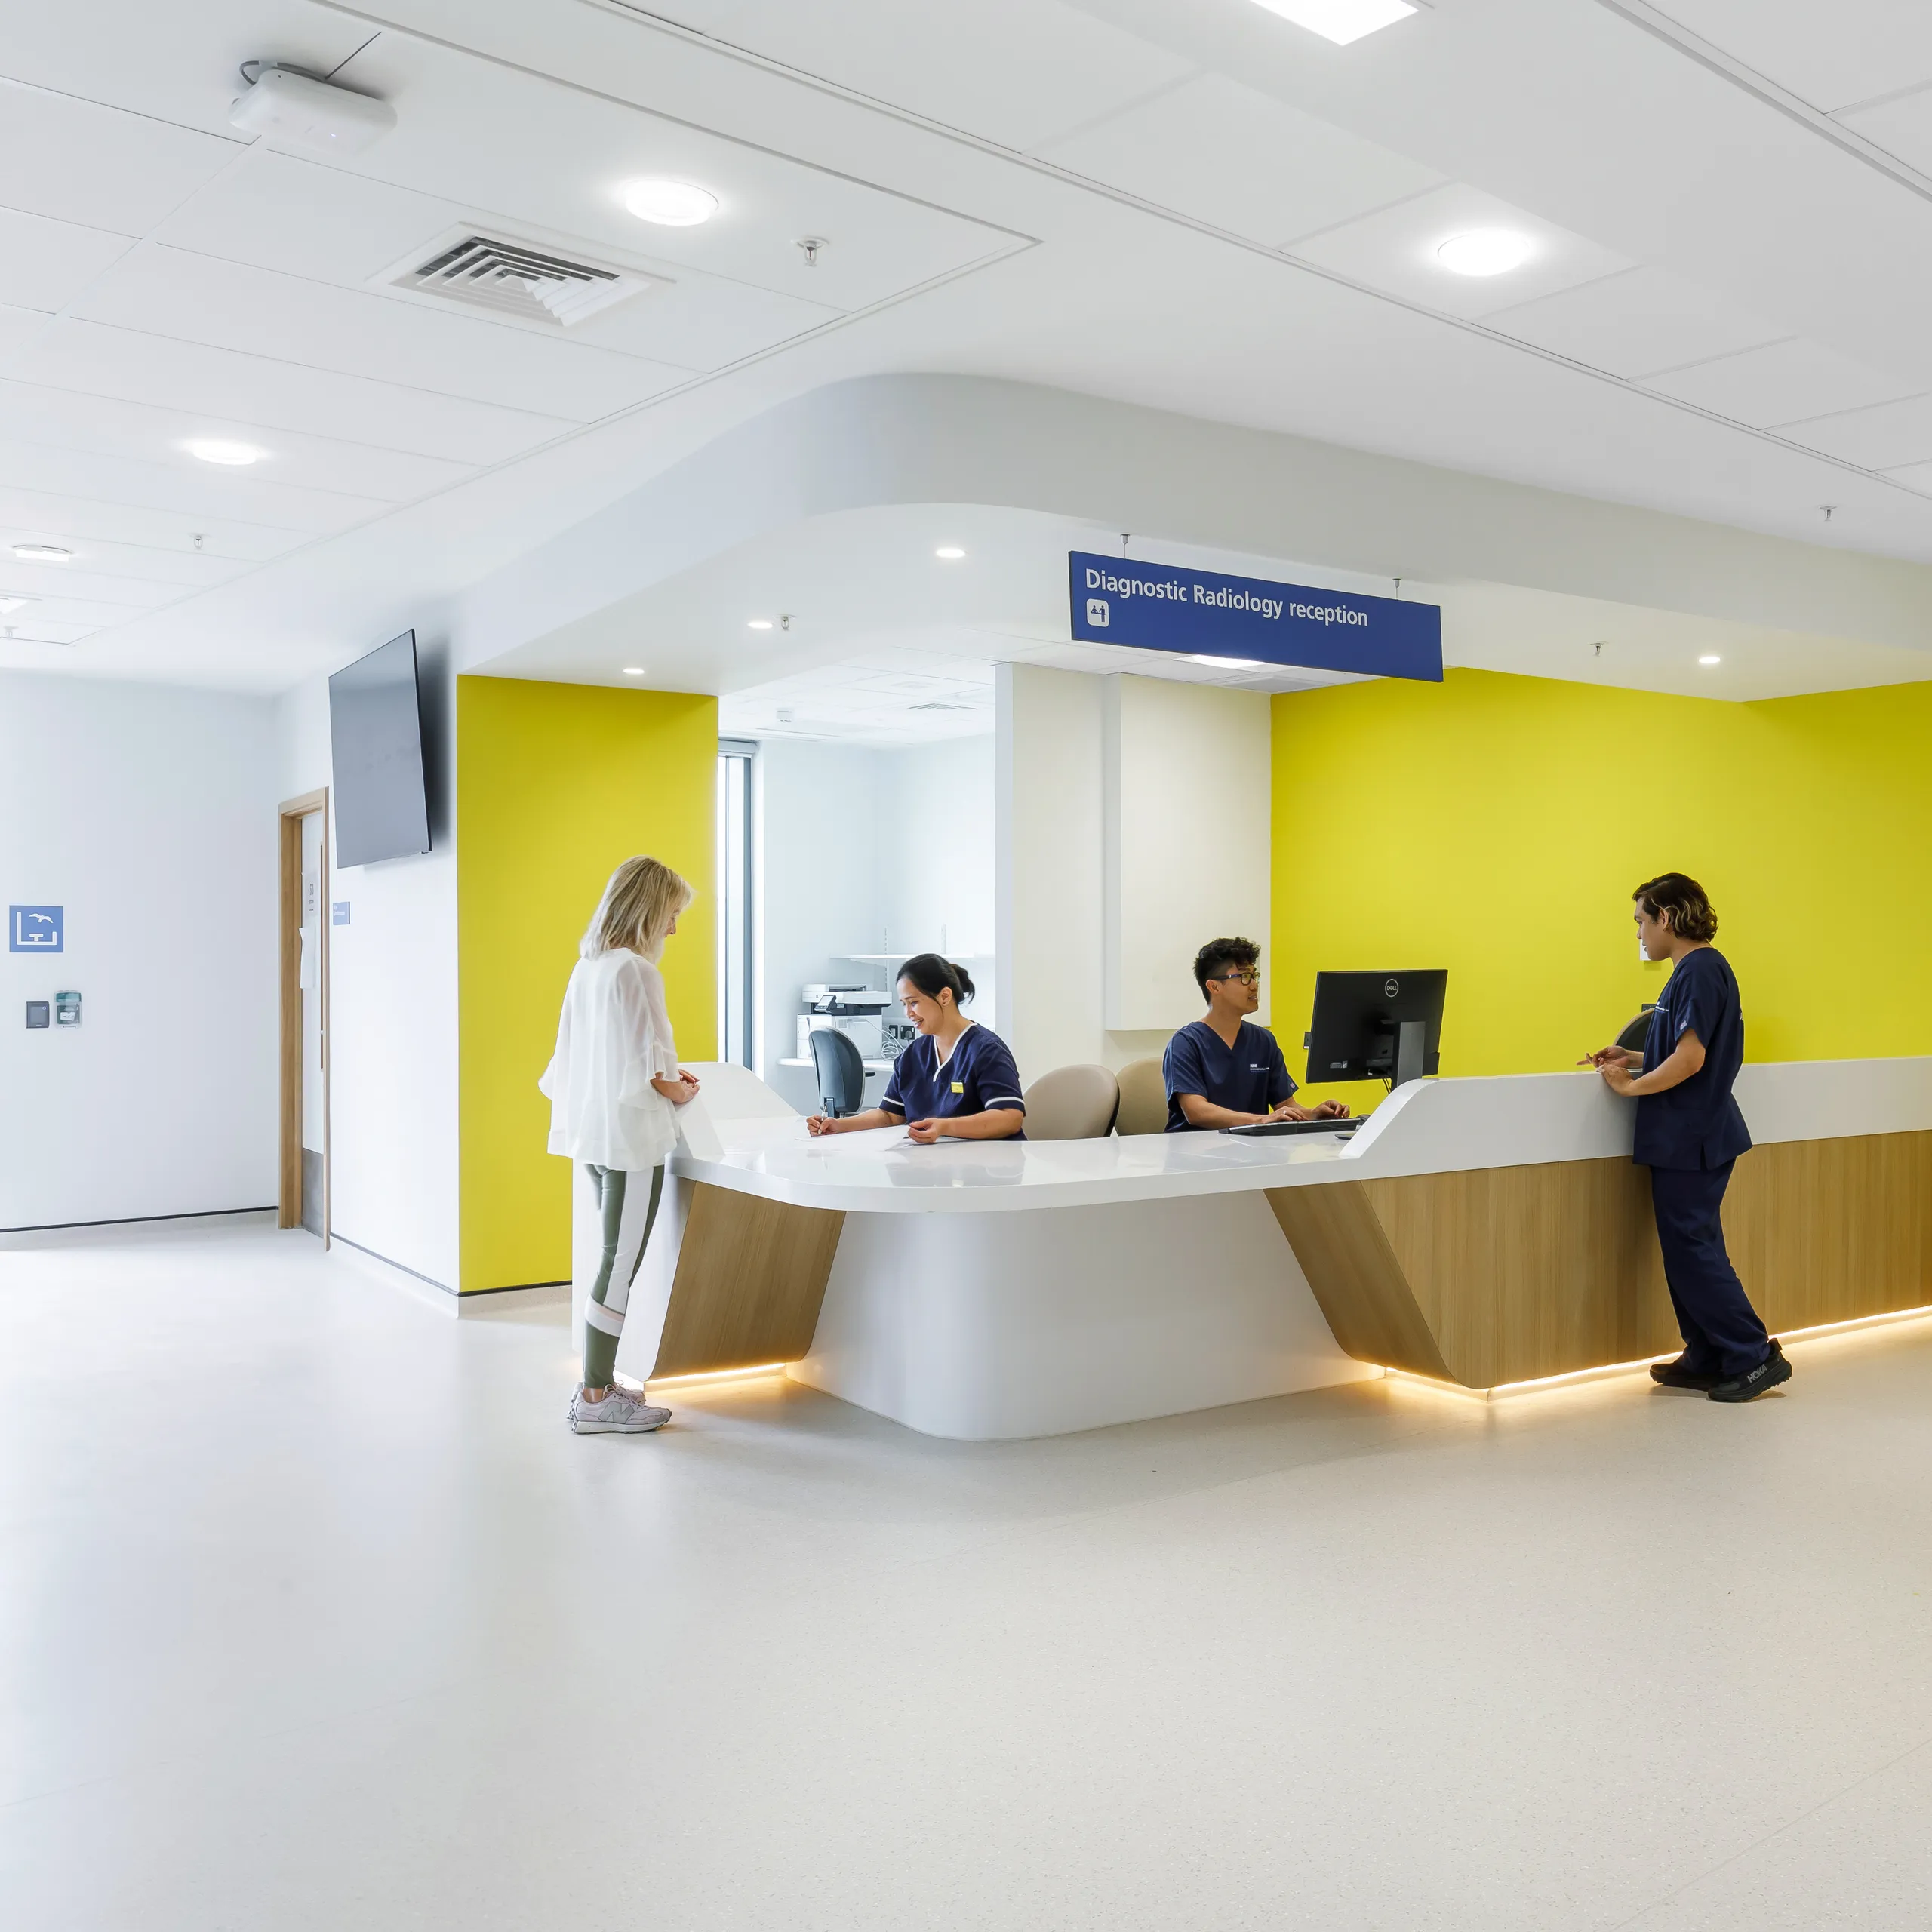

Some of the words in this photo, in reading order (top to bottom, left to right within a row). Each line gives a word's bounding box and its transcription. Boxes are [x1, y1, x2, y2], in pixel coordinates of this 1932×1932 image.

[1085, 568, 1187, 601] Diagnostic
[1194, 584, 1283, 620] Radiology
[1289, 601, 1368, 626] reception
[1746, 1364, 1768, 1383] HOKA
